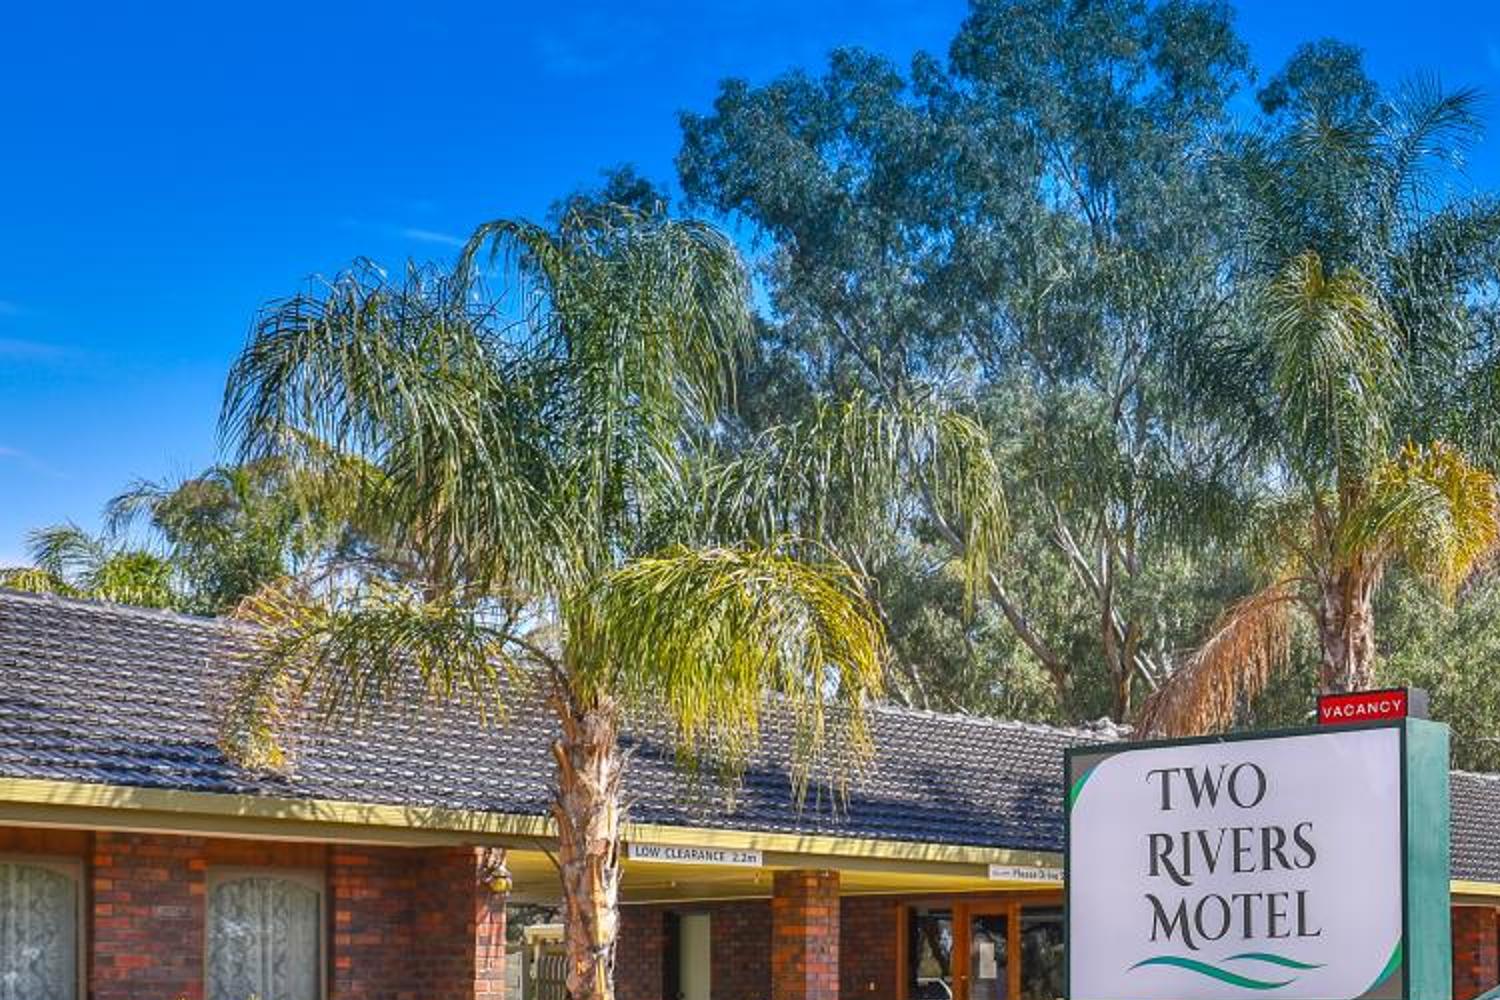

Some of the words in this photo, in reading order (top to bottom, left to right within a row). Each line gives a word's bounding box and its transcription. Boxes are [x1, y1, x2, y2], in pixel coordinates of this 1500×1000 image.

[1322, 700, 1401, 718] VACANCY
[1146, 762, 1267, 811] TWO
[635, 845, 660, 857] LOW
[665, 847, 724, 861] CLEARANCE
[1147, 821, 1317, 887] RIVERS
[1145, 890, 1322, 951] MOTEL
